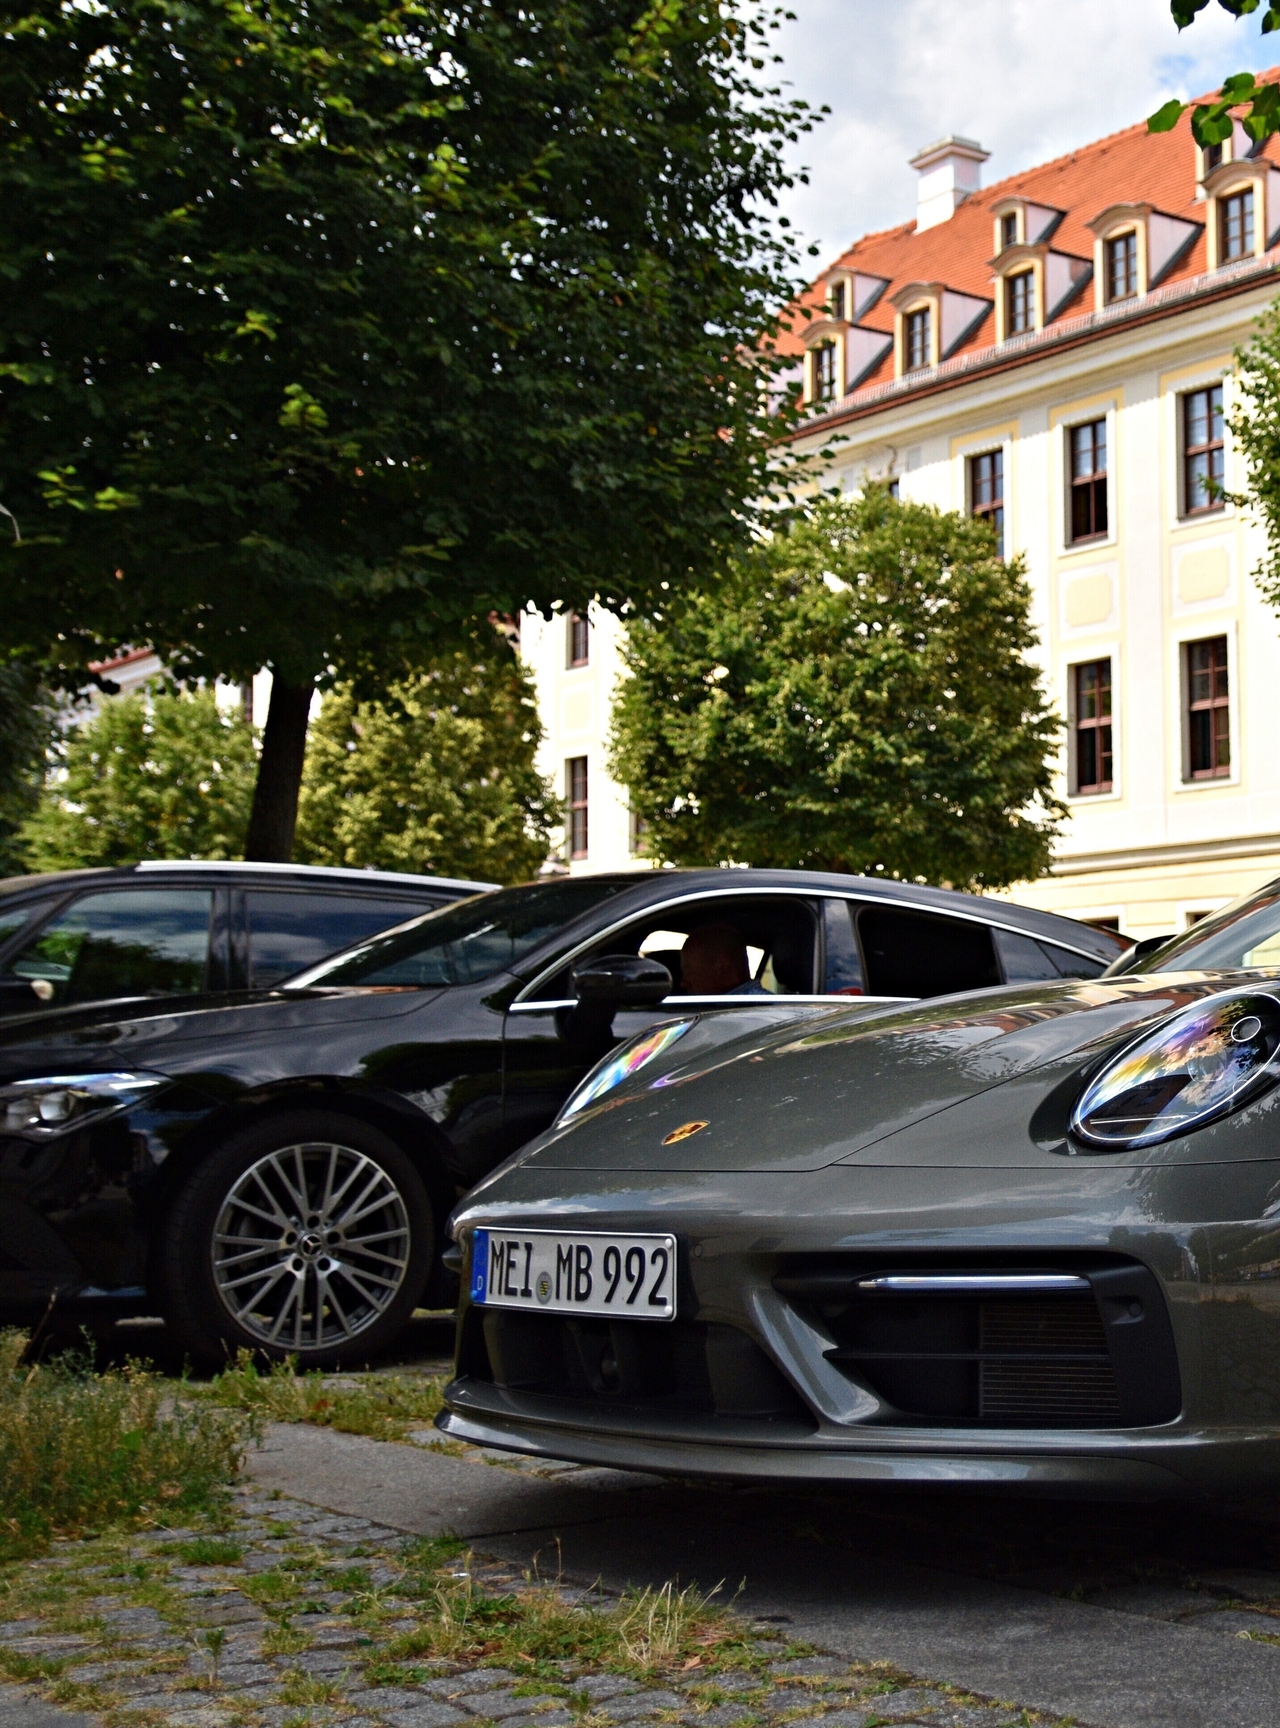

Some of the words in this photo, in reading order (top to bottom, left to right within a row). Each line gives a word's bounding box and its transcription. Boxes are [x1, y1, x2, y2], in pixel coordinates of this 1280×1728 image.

[489, 1239, 533, 1297] MEI
[555, 1243, 593, 1302] MB
[603, 1245, 668, 1306] 992
